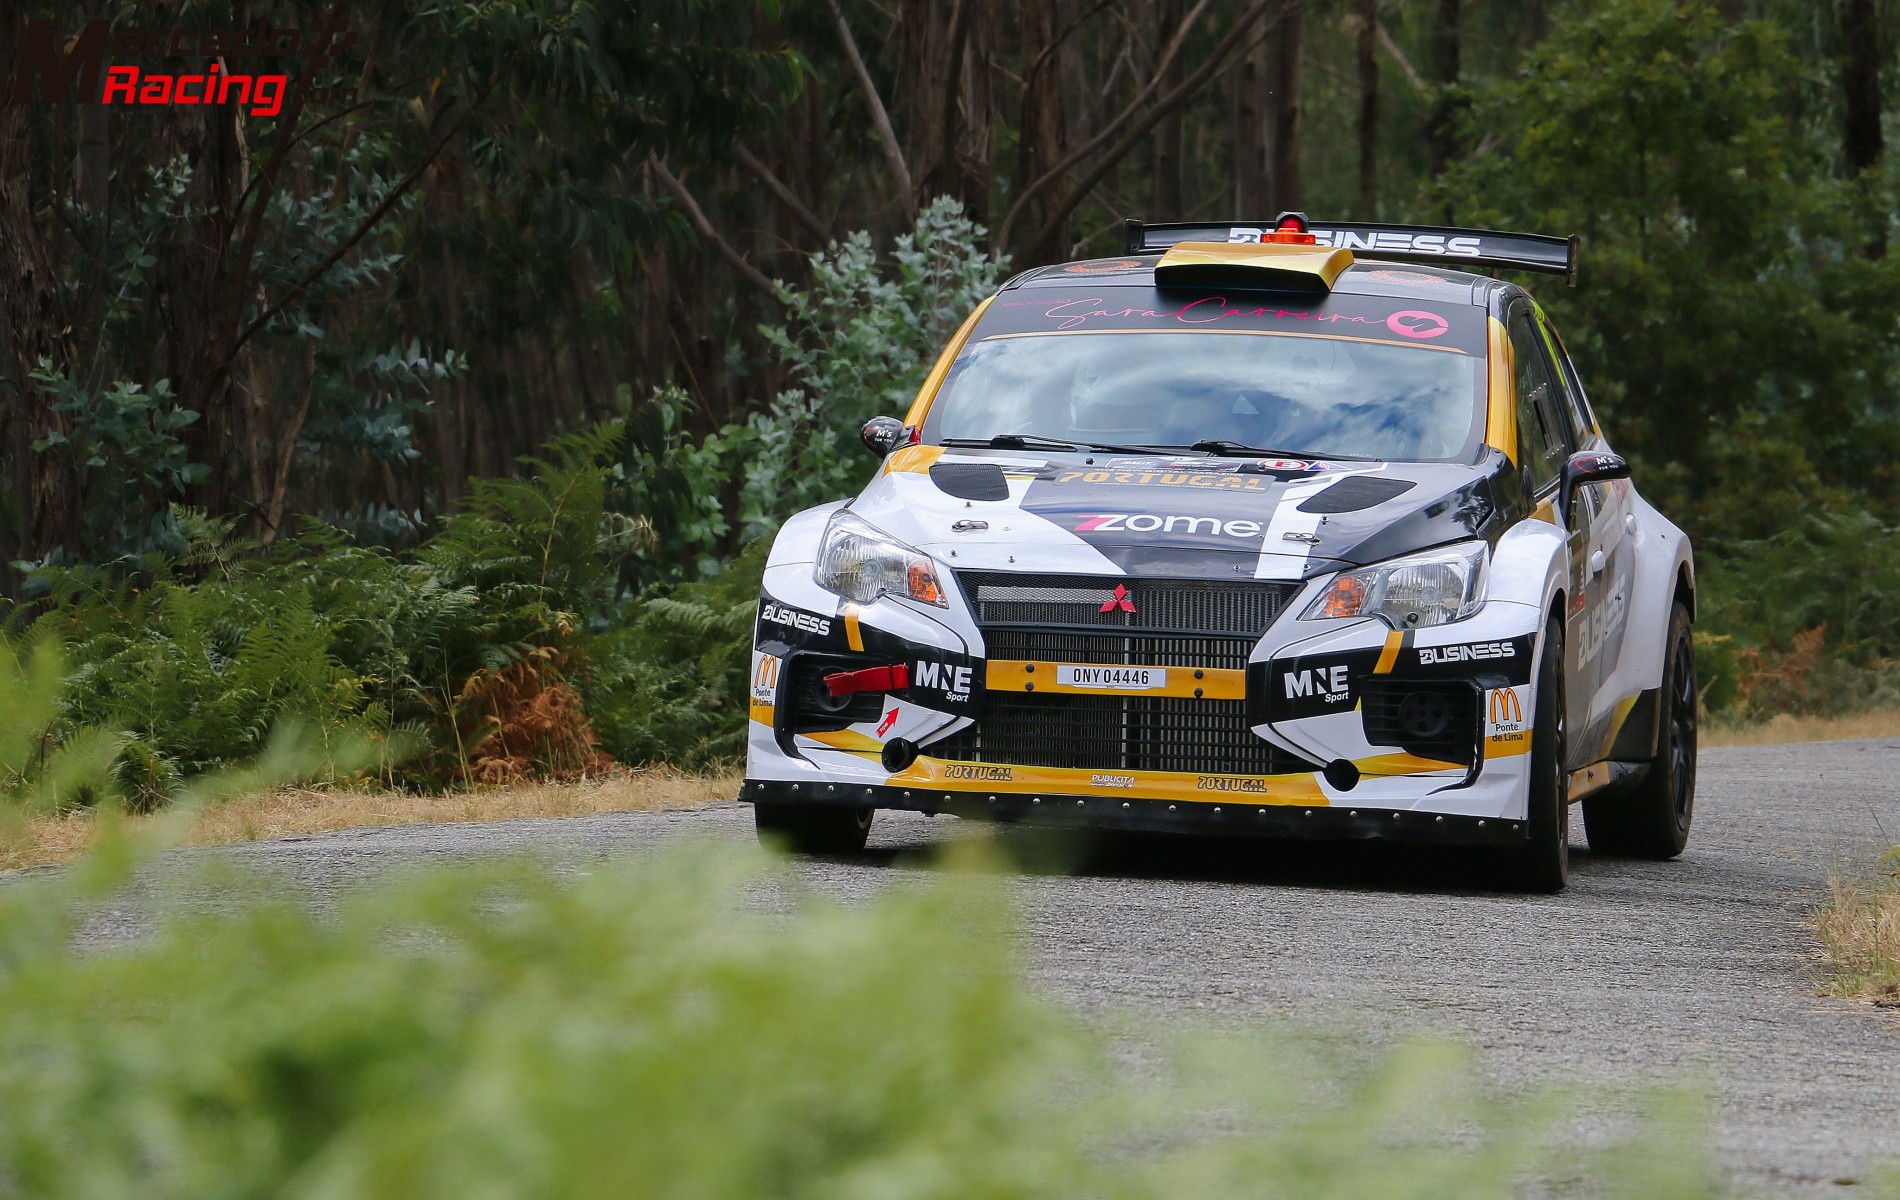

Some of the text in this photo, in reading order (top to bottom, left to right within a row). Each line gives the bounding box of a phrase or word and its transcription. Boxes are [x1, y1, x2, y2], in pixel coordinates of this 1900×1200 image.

[1228, 227, 1481, 257] BSINESS
[1045, 296, 1385, 329] Sara Carreira
[1595, 456, 1614, 464] M's
[1059, 472, 1266, 491] PORTUGAL
[761, 605, 831, 636] BUSINESS
[1419, 642, 1516, 665] BUSINESS
[755, 688, 771, 697] Ponte
[945, 691, 969, 703] Sport
[1324, 691, 1349, 704] Sport
[759, 697, 773, 706] Lima
[879, 720, 890, 733] TOW
[1495, 723, 1519, 732] Ponte
[1492, 732, 1524, 742] de Lima
[945, 765, 1013, 782] PORTUGAL
[1197, 776, 1267, 793] PORTUGAL
